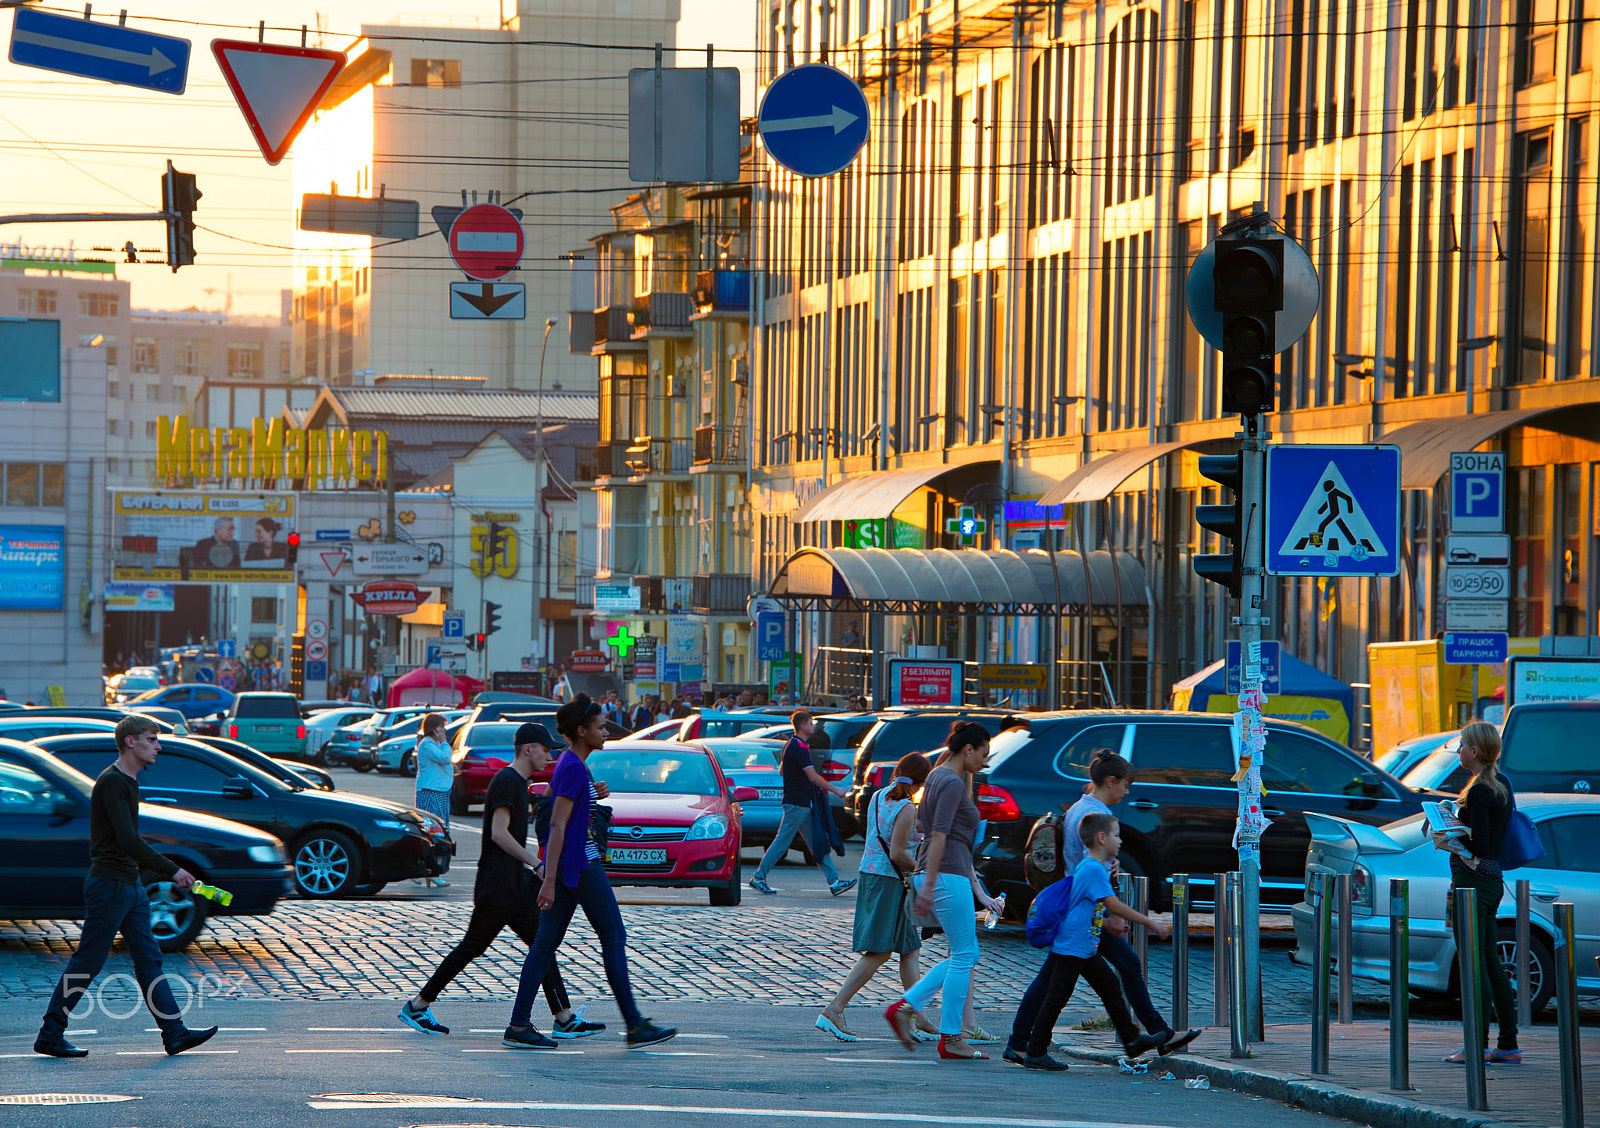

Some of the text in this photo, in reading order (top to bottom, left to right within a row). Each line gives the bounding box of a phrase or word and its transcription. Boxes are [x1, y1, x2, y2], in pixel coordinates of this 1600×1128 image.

[156, 415, 390, 491] МегаМаркет
[1453, 456, 1502, 471] ЗОНА
[1466, 478, 1491, 514] P
[0, 547, 58, 567] апарк
[1452, 577, 1499, 589] 10 25 50
[364, 591, 417, 602] КРИЛА
[766, 621, 782, 642] P
[1458, 638, 1495, 647] ПРАЦЮЄ
[761, 646, 782, 659] 24h
[1453, 650, 1500, 658] ПАРКОМАТ
[909, 668, 950, 676] БЕЗЛІМІТИ
[1538, 674, 1598, 683] ПриватБанк
[1527, 694, 1550, 702] Купуй
[611, 850, 664, 860] AA 4175 CX
